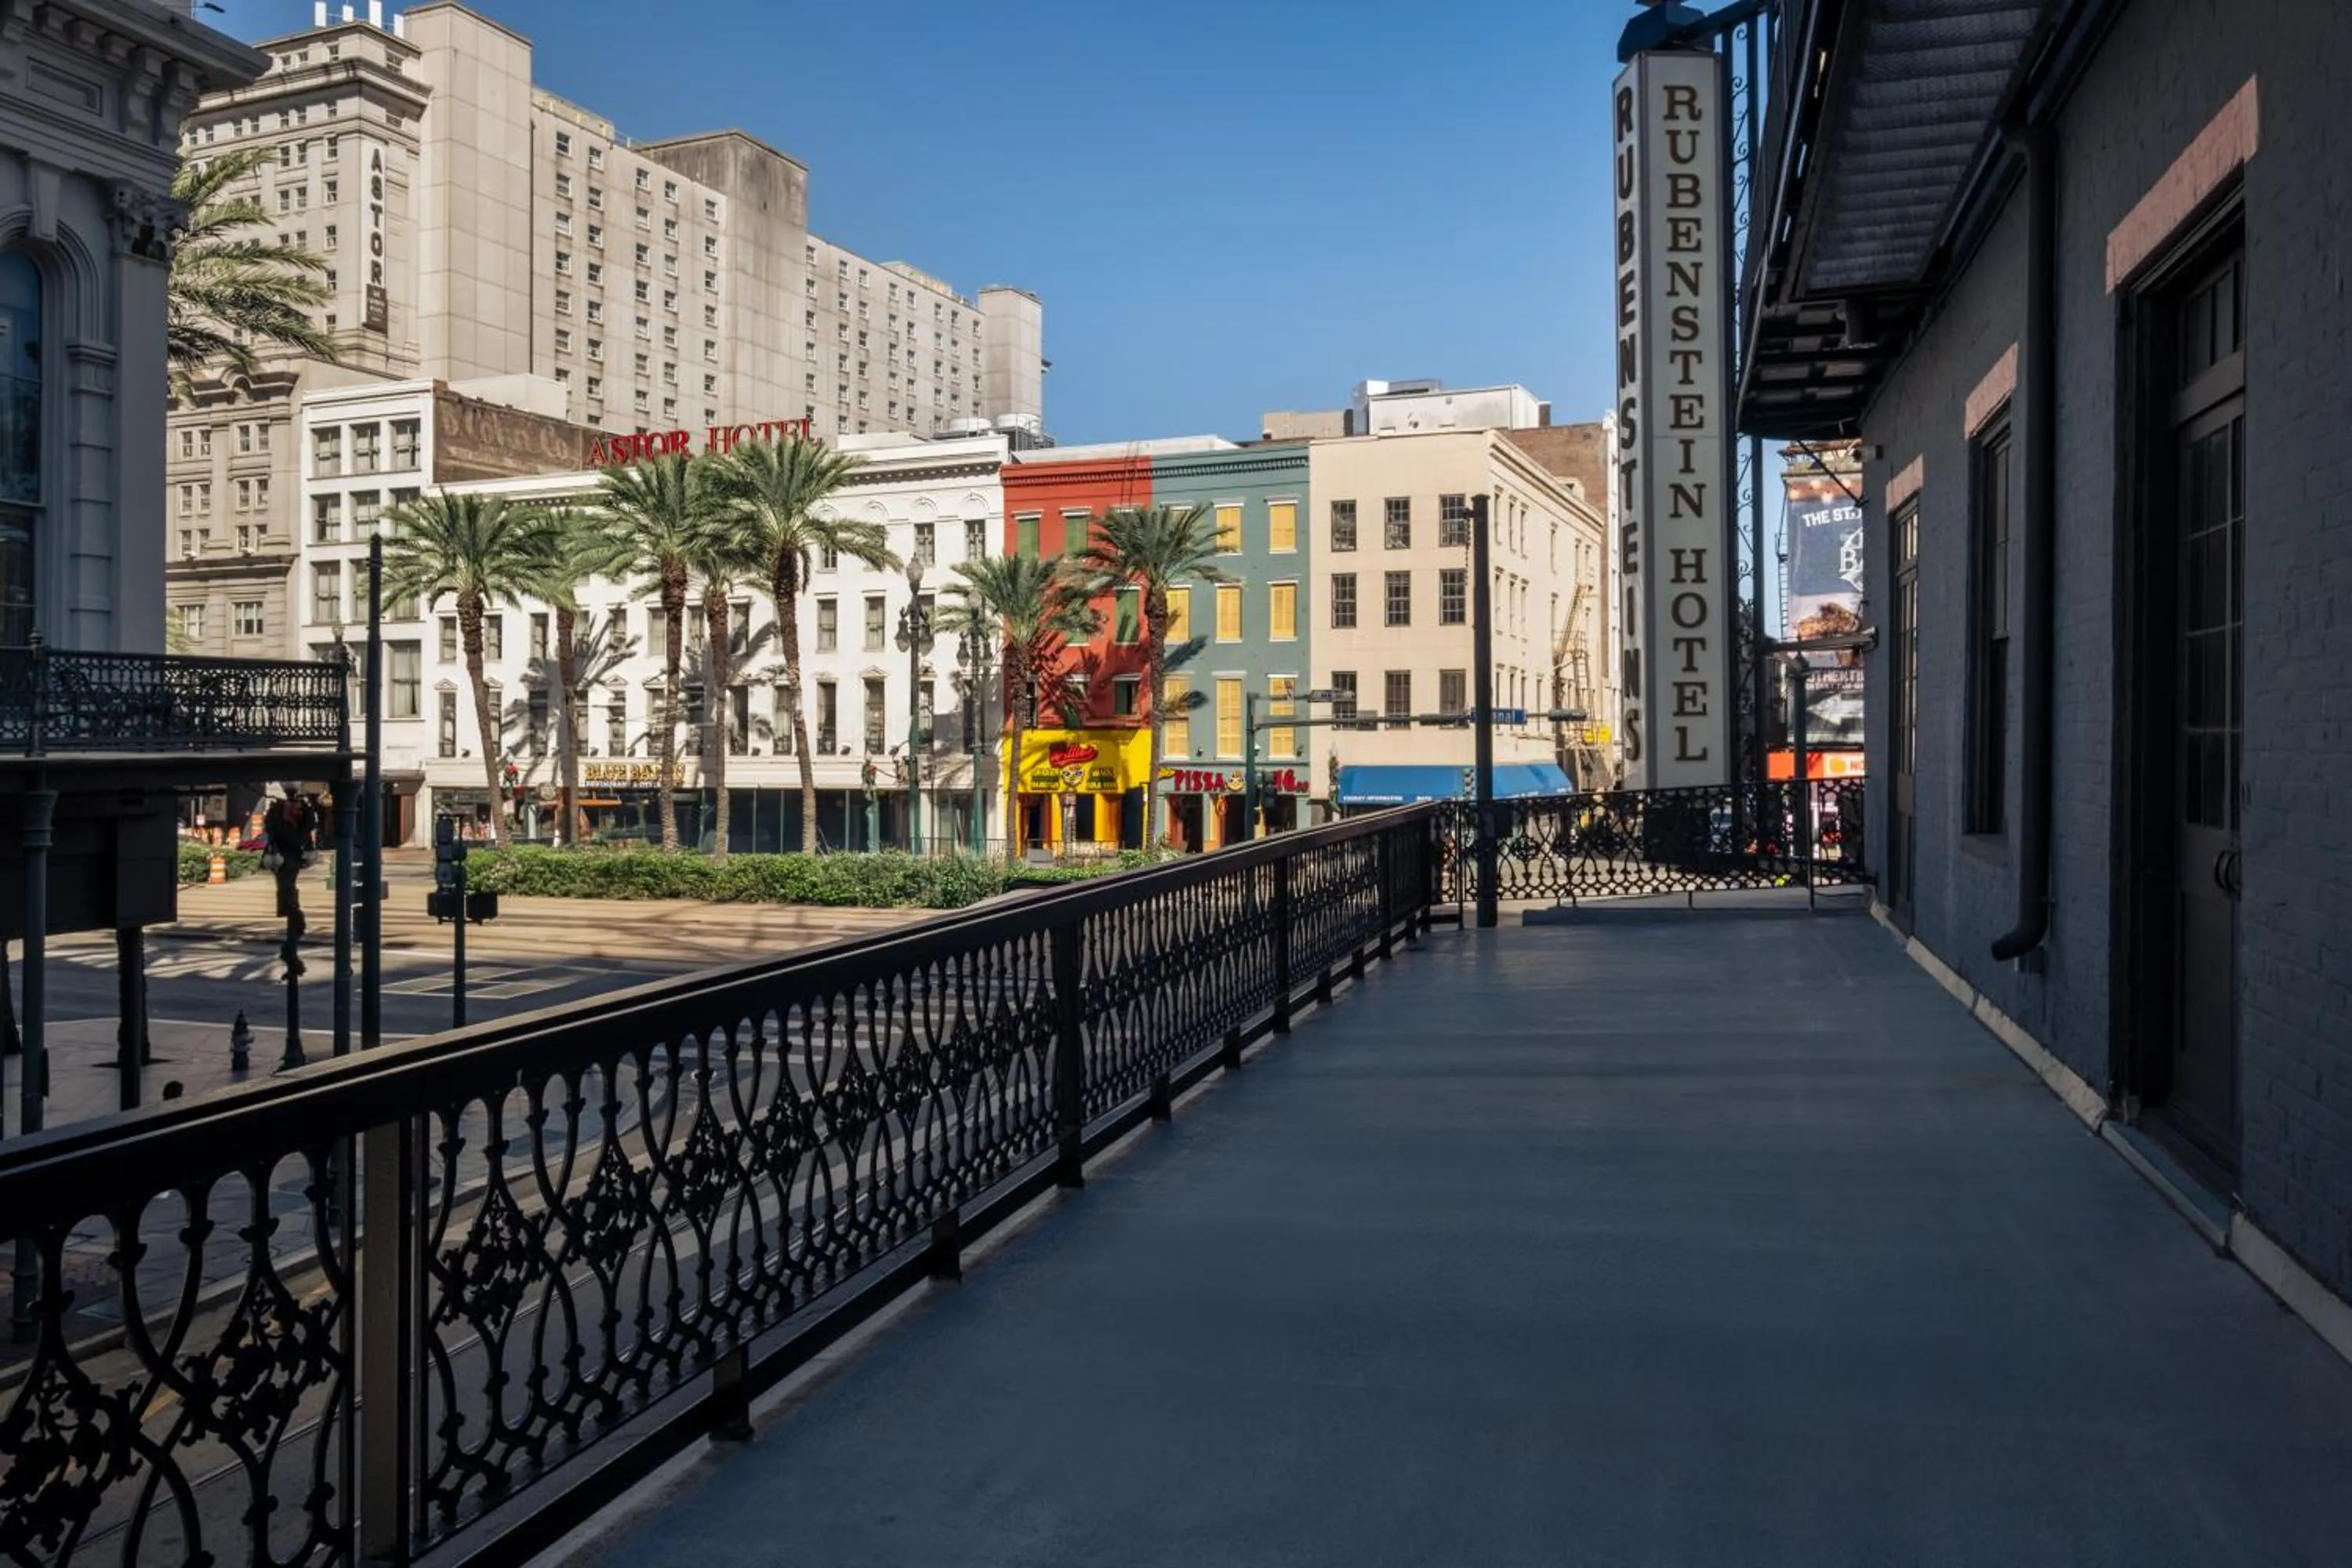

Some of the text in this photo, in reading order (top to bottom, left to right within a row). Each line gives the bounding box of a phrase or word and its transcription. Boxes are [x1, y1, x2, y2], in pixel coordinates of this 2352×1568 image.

[370, 148, 383, 285] ASTOR
[590, 429, 692, 466] ASTOR
[1617, 85, 1641, 763] RUBENSTEINS
[1663, 85, 1708, 762] RUBENSTEIN HOTEL
[1802, 509, 1831, 527] THE
